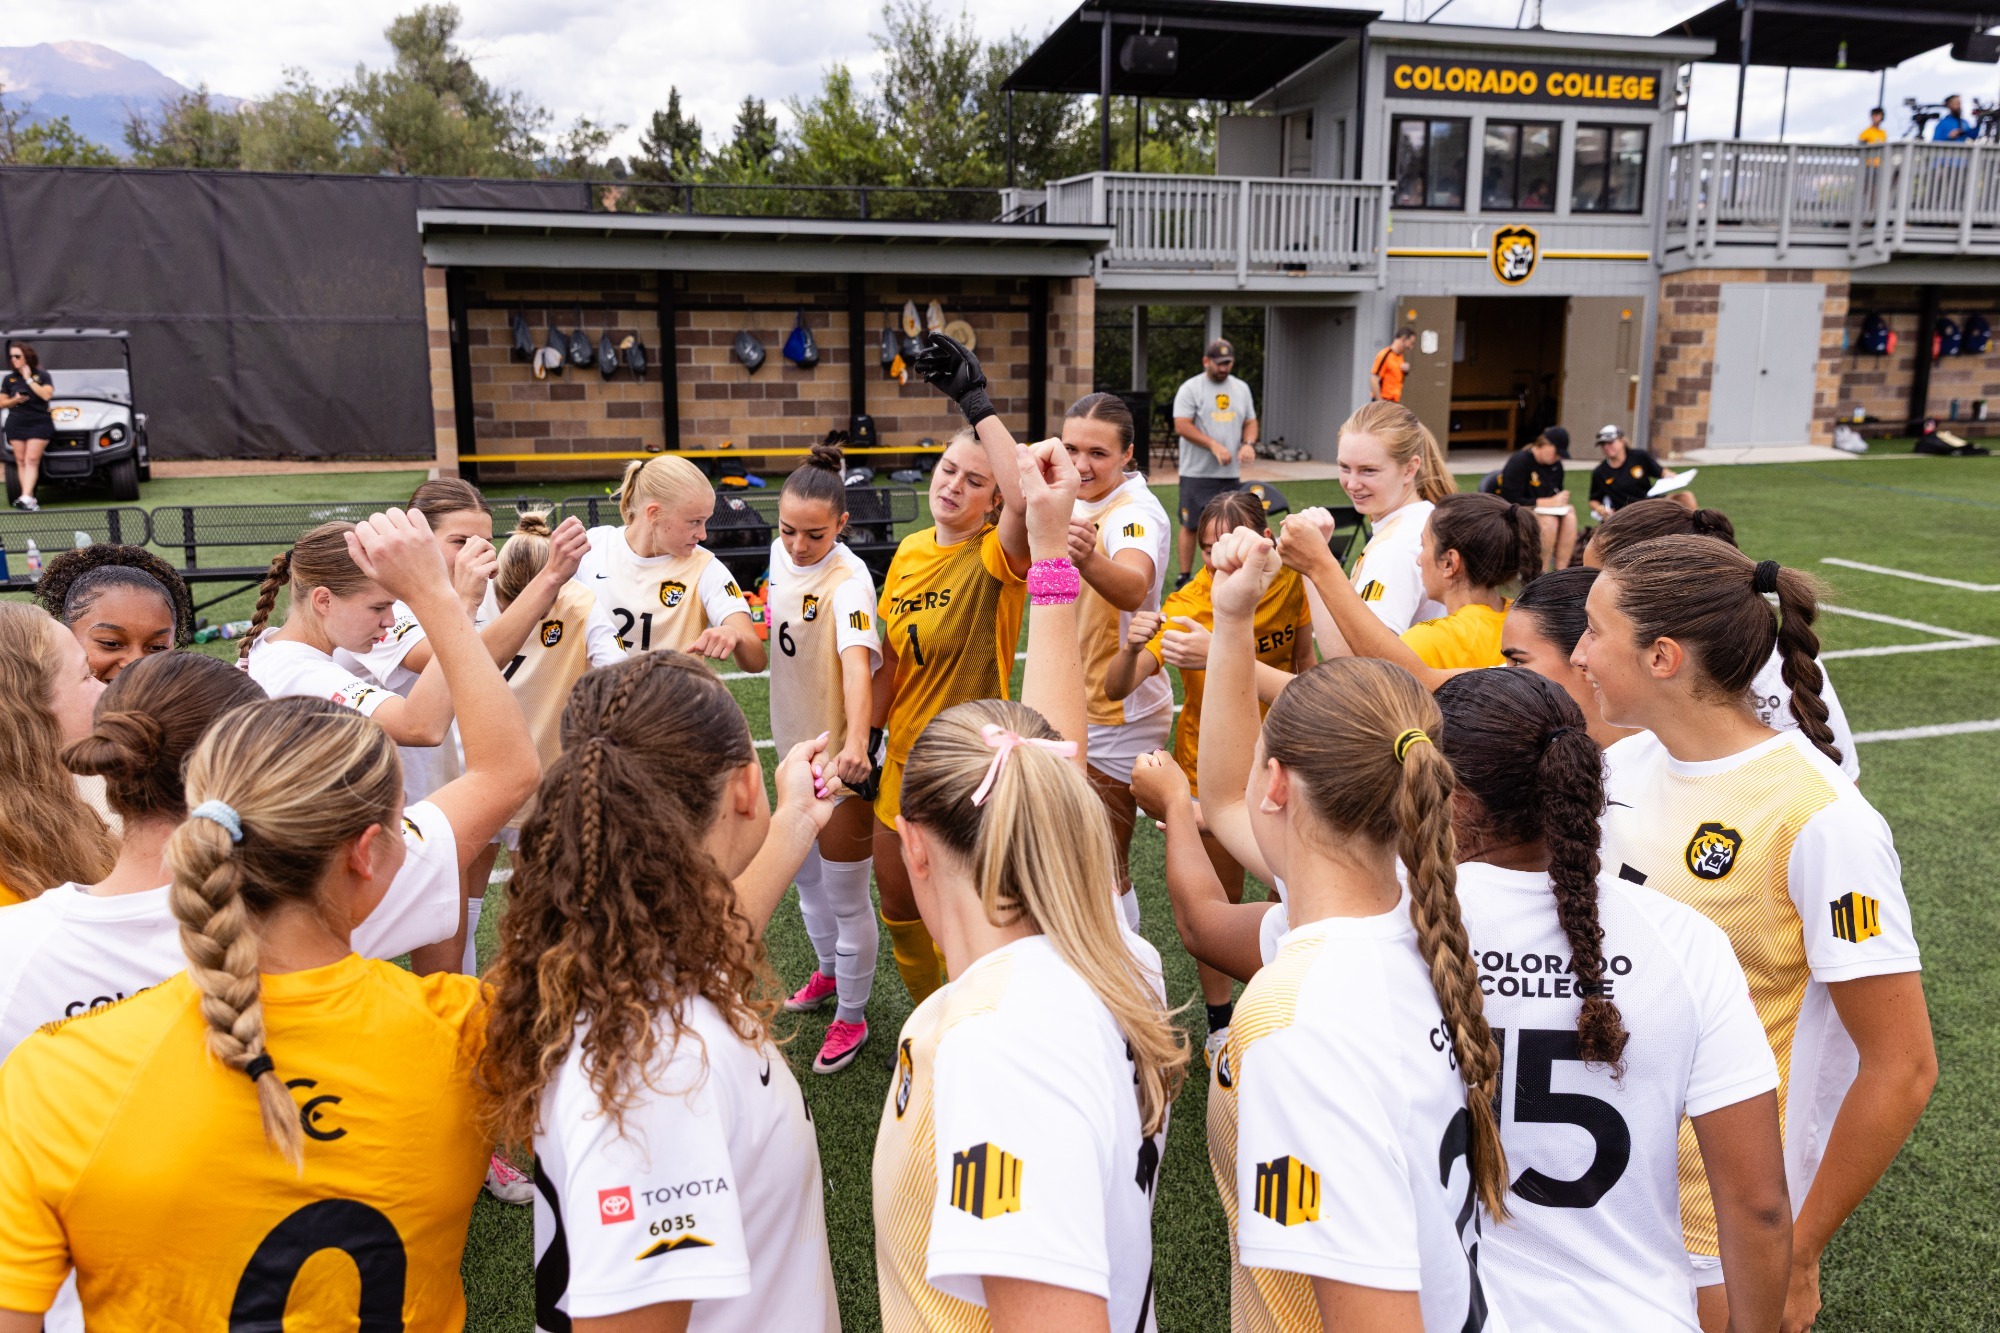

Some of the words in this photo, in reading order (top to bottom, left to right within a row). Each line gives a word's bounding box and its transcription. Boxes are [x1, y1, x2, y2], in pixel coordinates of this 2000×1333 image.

[1393, 64, 1538, 96] COLORADO
[1545, 72, 1656, 101] COLLEGE
[612, 607, 653, 651] 21
[779, 621, 796, 657] 6
[907, 623, 924, 666] 1
[1258, 624, 1294, 653] ERS
[642, 1177, 728, 1206] TOYOTA
[649, 1214, 696, 1236] 6035
